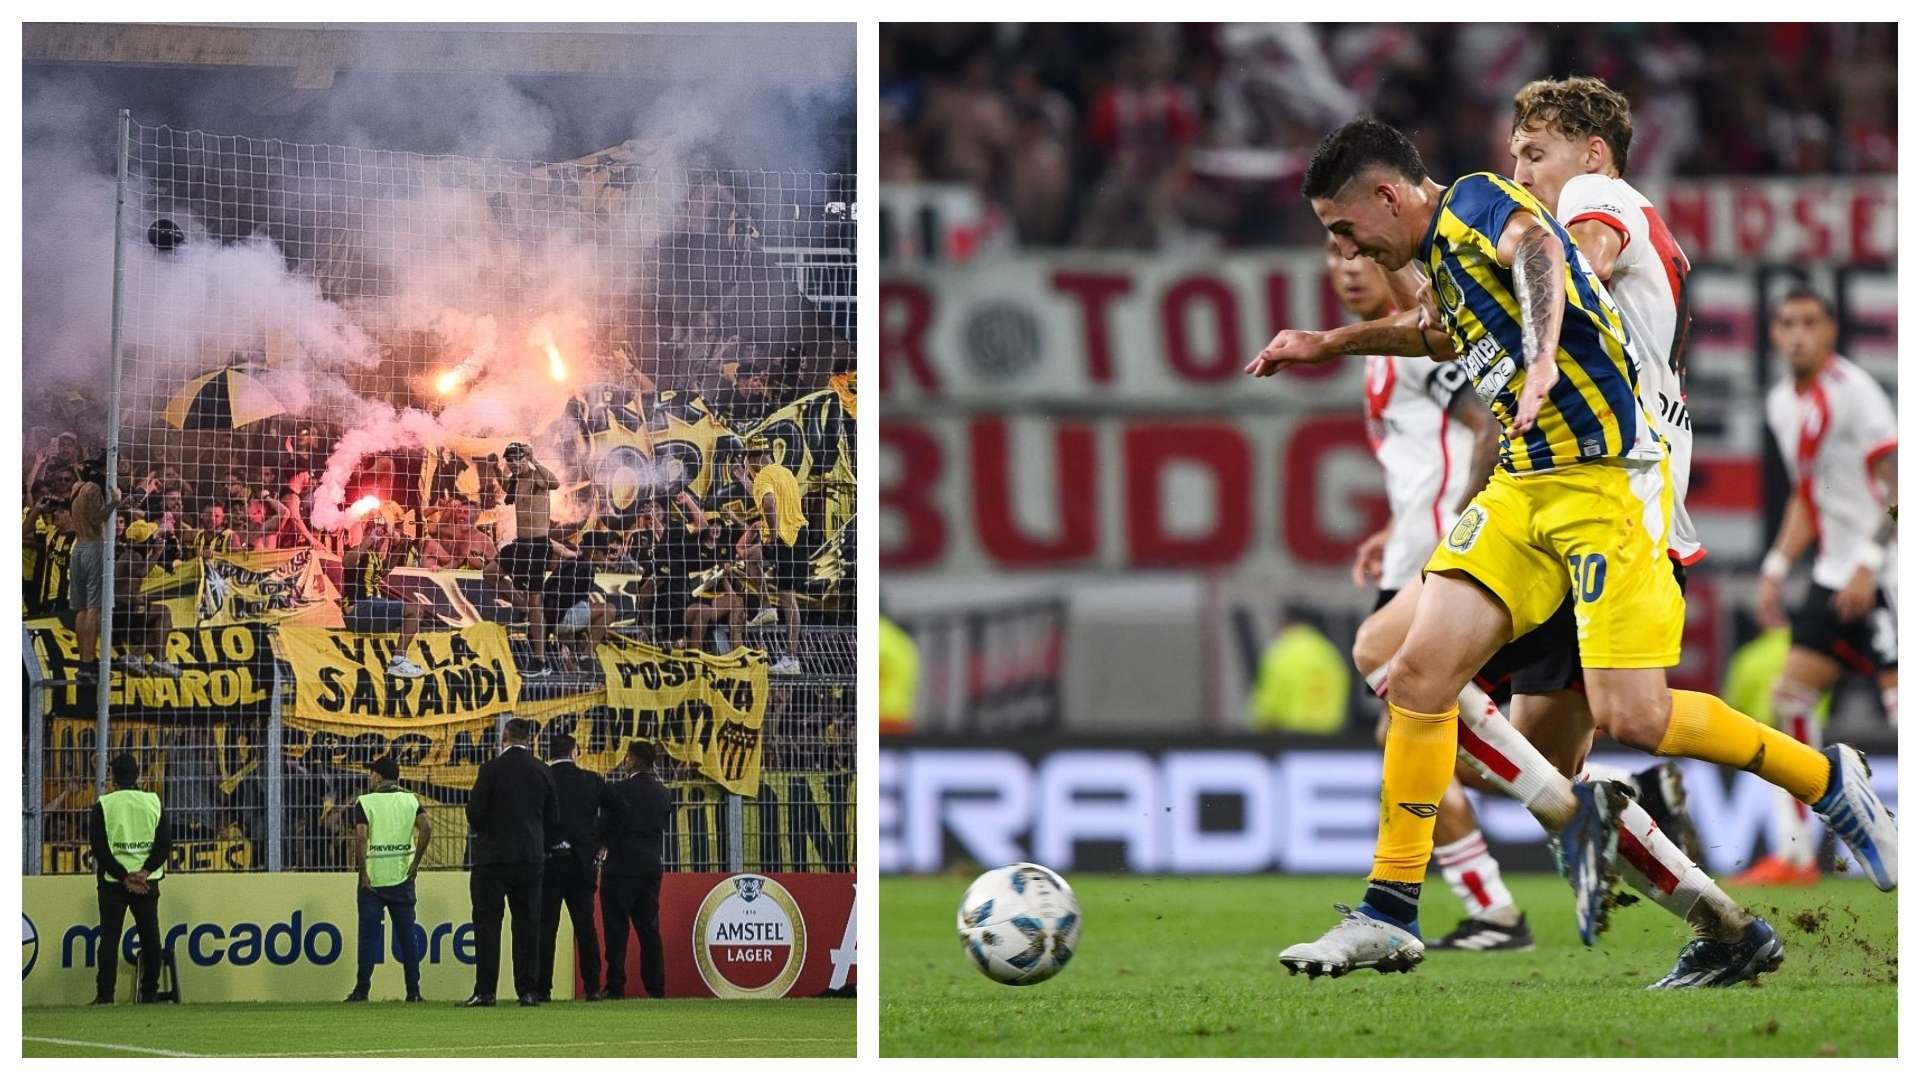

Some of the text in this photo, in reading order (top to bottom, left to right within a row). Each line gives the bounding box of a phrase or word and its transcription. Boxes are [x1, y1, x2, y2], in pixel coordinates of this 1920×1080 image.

[316, 658, 508, 718] SARANDI
[716, 922, 783, 941] AMSTEL
[727, 949, 772, 962] LAGER
